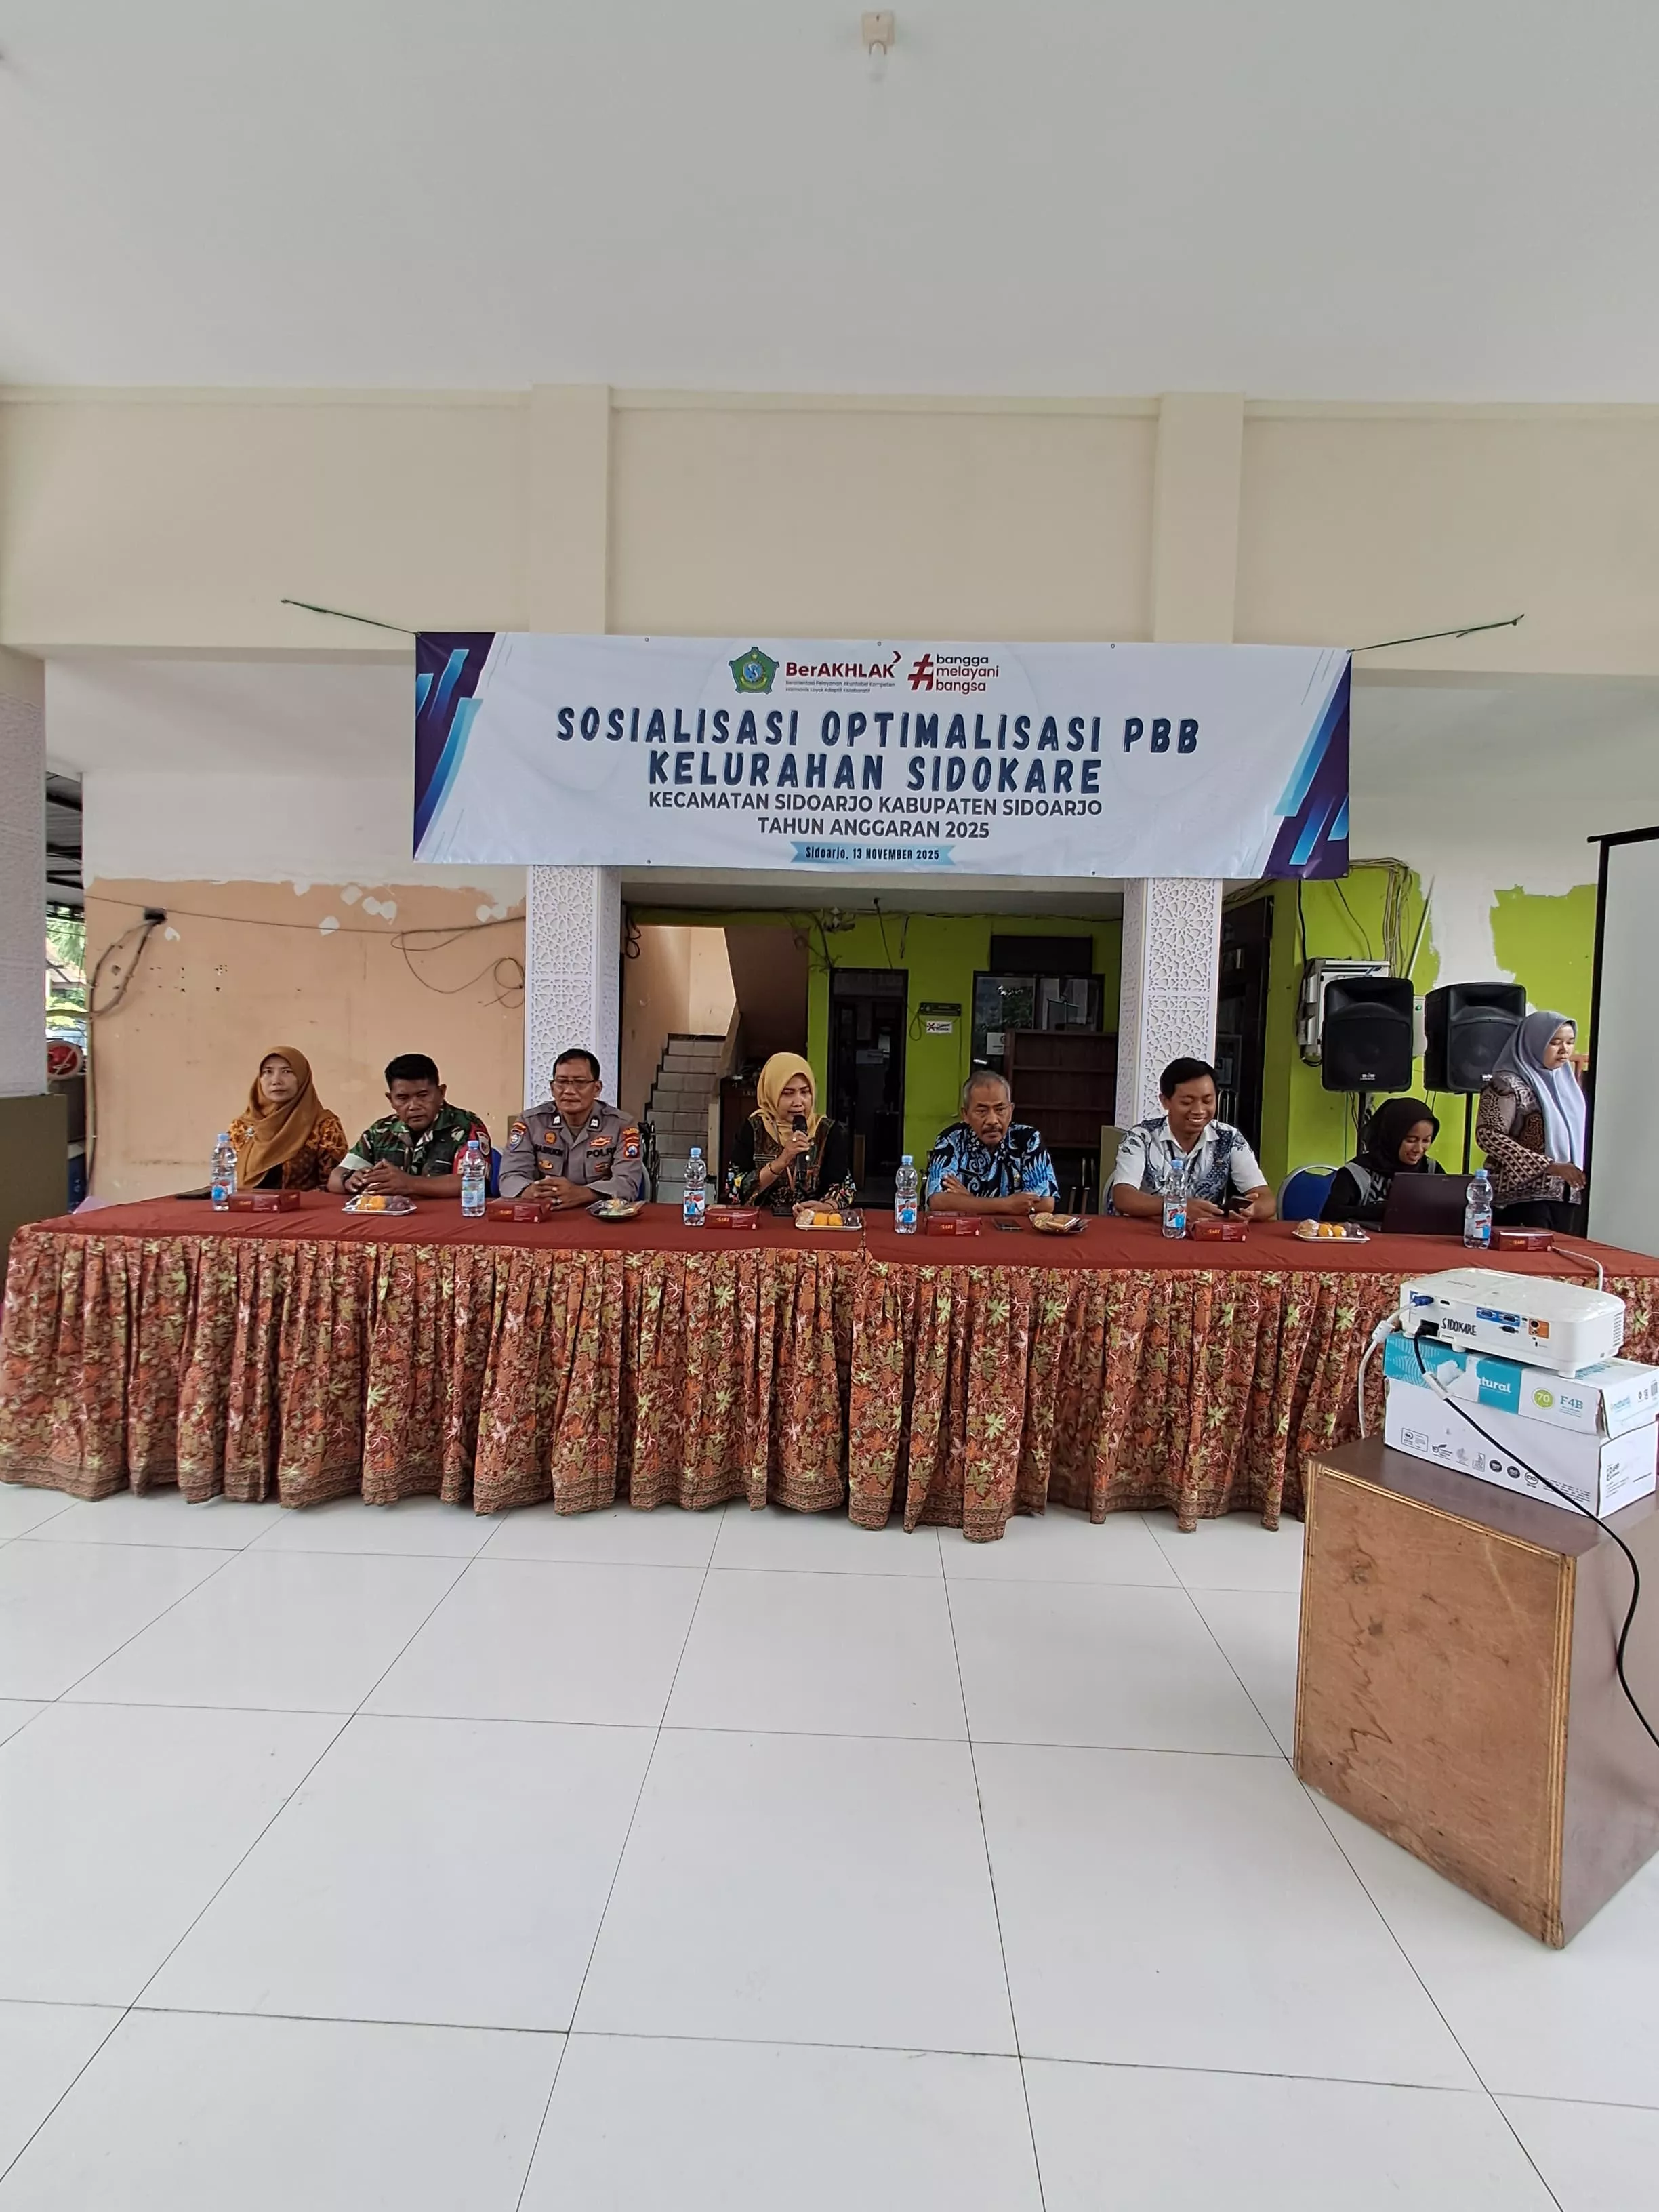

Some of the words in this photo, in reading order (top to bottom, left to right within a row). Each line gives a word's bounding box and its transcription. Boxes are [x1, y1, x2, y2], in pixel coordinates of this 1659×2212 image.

[936, 653, 989, 667] bangga
[785, 661, 895, 678] BerAKHLAK
[936, 665, 999, 680] melayani
[935, 679, 986, 695] bangsa
[556, 706, 798, 746] SOSIALISASI
[821, 710, 1101, 752] OPTIMALISASI
[1123, 717, 1199, 754] PBB
[649, 750, 884, 790] KELURAHAN
[907, 755, 1101, 794] SIDOKARE
[649, 790, 769, 810] KECAMATAN
[775, 793, 873, 813] SIDOARJO
[878, 796, 997, 816] KABUPATEN
[1002, 798, 1103, 817] SIDOARJO
[757, 817, 824, 835] TAHUN
[829, 818, 940, 838] ANGGARAN
[945, 821, 989, 838] 2025
[852, 848, 863, 859] 13
[865, 848, 913, 861] NOVEMBER
[916, 849, 939, 860] 2025
[1441, 1317, 1477, 1336] SIDOKARE
[1479, 1376, 1511, 1393] tural
[1536, 1392, 1551, 1404] 70
[1559, 1395, 1584, 1410] F4B
